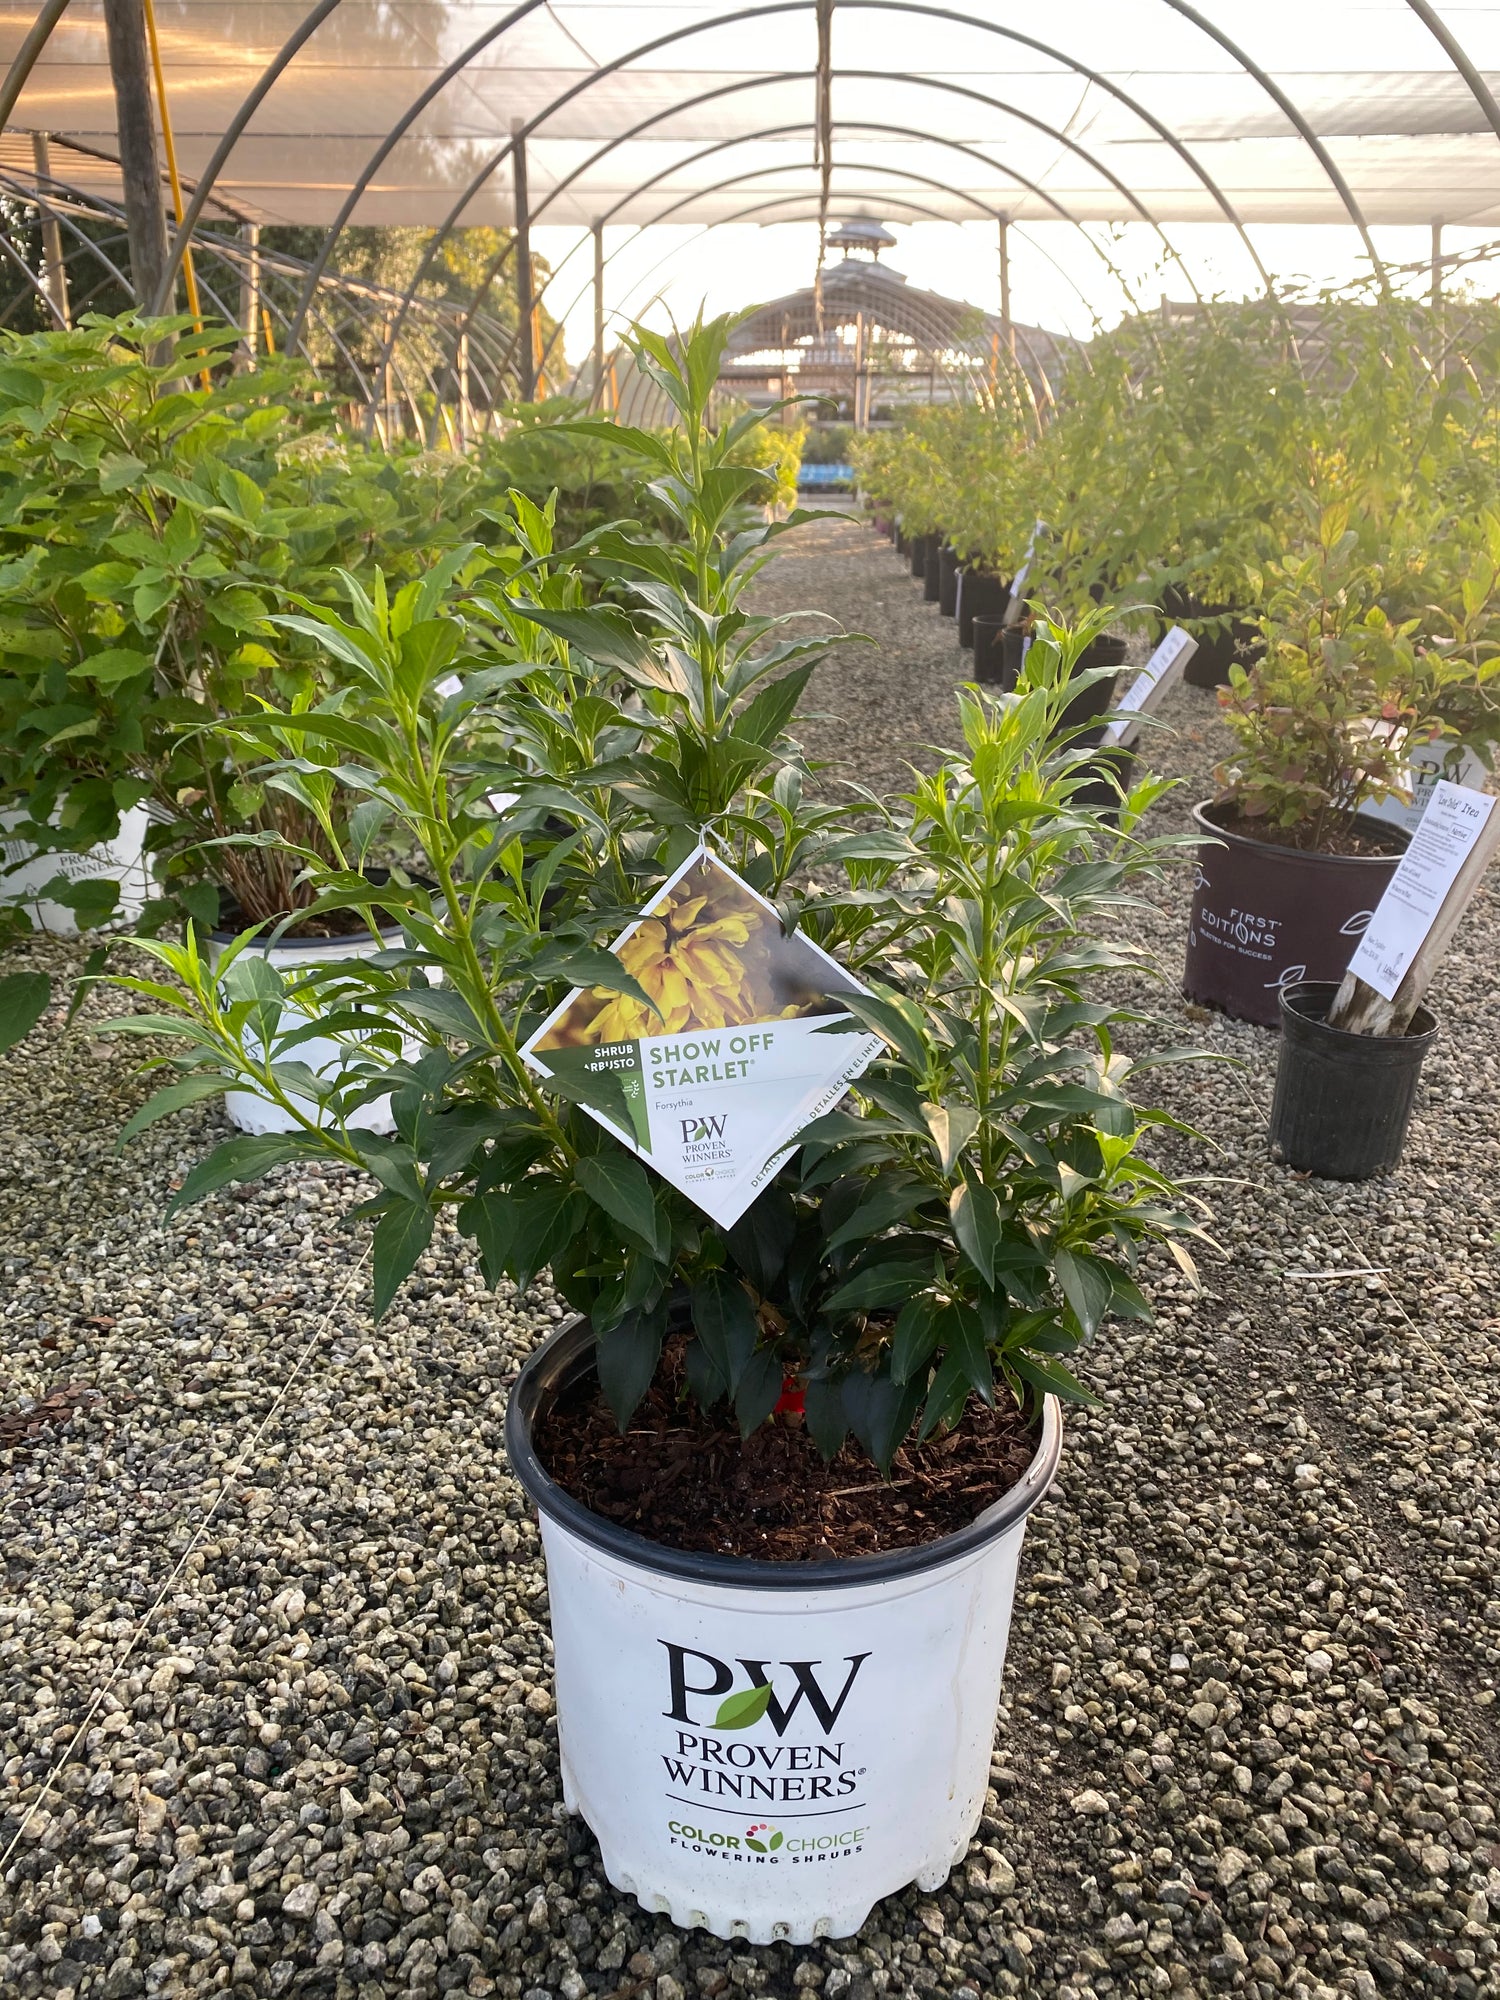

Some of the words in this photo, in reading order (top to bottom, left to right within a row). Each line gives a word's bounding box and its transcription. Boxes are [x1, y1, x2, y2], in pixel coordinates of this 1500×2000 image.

[1201, 908, 1276, 947] EDITIONS
[1230, 908, 1279, 930] FIRST
[1223, 941, 1236, 950] FOR
[1238, 947, 1272, 961] SUCCESS
[594, 1044, 634, 1058] SHRUB
[650, 1039, 721, 1064] SHOW
[729, 1033, 774, 1053] OFF
[655, 1099, 693, 1111] Forsythia
[751, 1154, 782, 1188] DETAILS
[809, 1081, 844, 1119] DETALLES
[843, 1068, 854, 1081] EN
[853, 1057, 863, 1069] EL
[861, 1037, 881, 1058] INTE
[679, 1114, 728, 1144] PW
[685, 1140, 726, 1153] PROVEN
[657, 1638, 873, 1737] PW
[675, 1730, 846, 1771] PROVEN
[668, 1820, 741, 1850] COLOR
[786, 1827, 866, 1851] CHOICE
[670, 1837, 779, 1864] FLOWERING
[792, 1845, 863, 1864] SHRUBS
